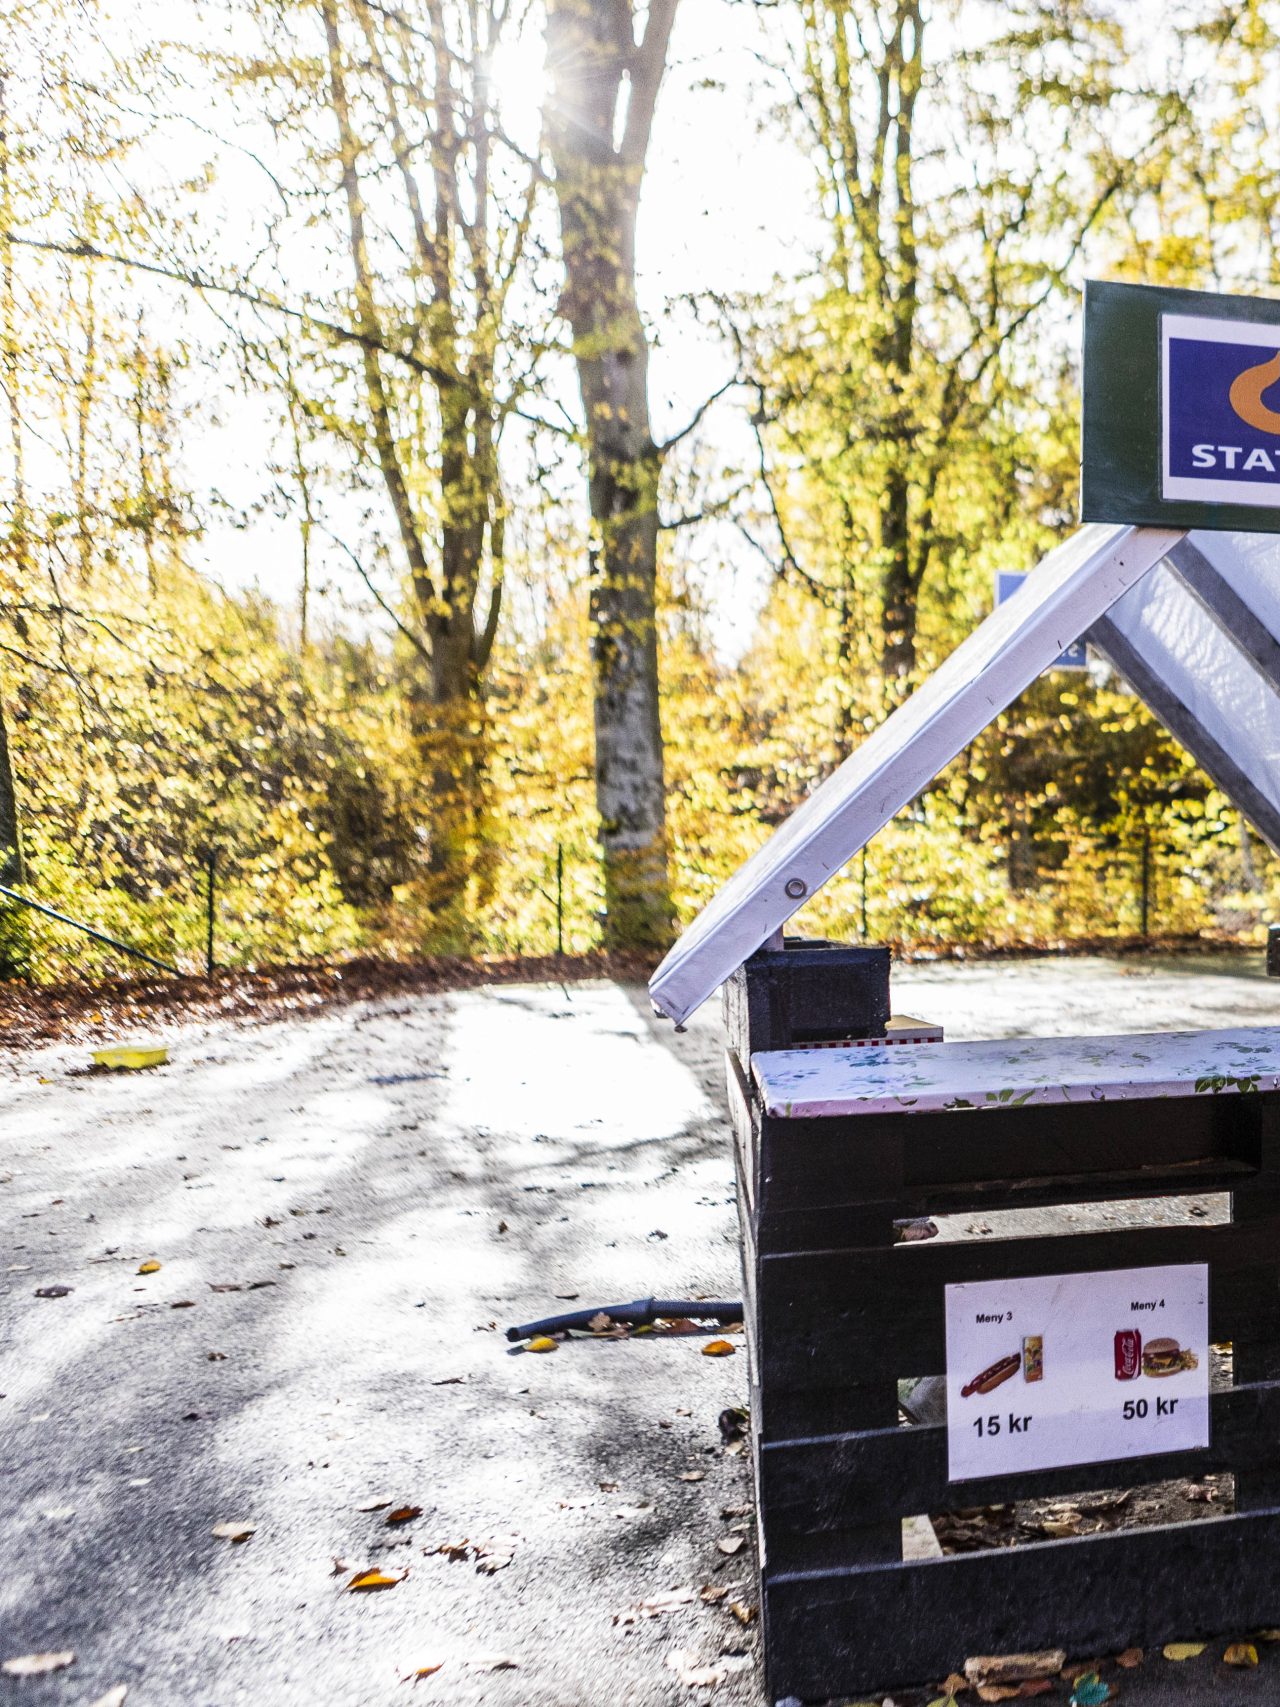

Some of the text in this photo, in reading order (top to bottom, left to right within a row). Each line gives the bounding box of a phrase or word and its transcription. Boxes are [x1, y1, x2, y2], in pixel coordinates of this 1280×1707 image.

[1130, 1298, 1166, 1311] Meny 4
[975, 1311, 1013, 1324] Meny 3
[1122, 1396, 1179, 1421] 50 kr
[973, 1413, 1033, 1438] 15 kr
